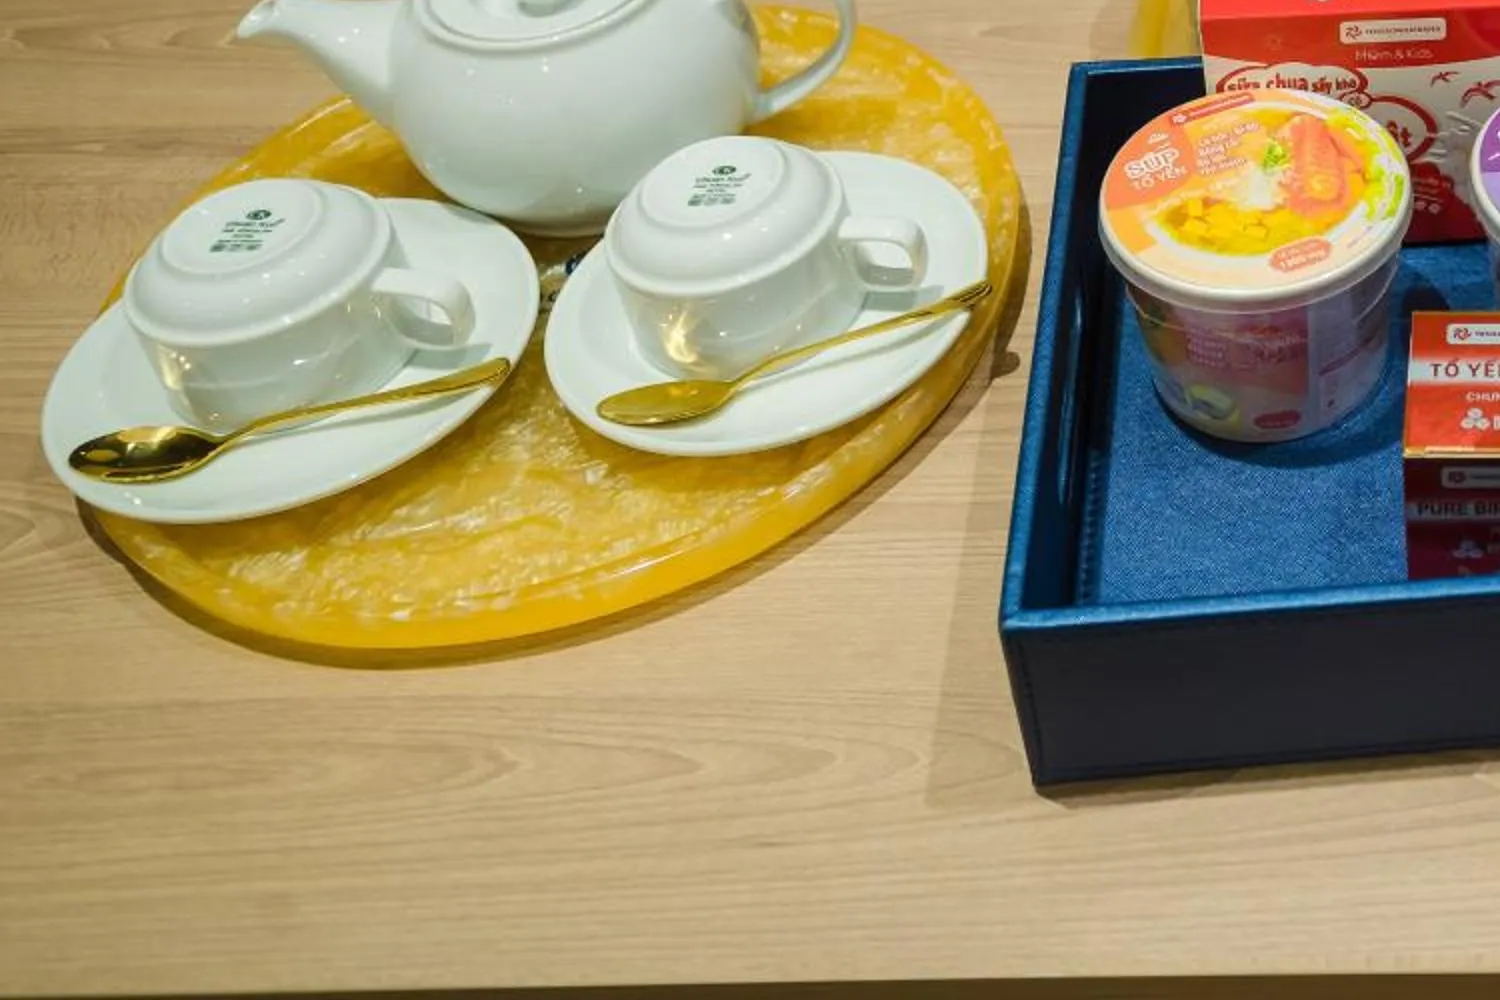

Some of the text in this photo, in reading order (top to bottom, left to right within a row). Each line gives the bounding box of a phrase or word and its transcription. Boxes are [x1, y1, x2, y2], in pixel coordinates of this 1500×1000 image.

[1266, 73, 1309, 91] chua
[1430, 357, 1460, 378] TỔ
[1416, 502, 1470, 517] PURE
